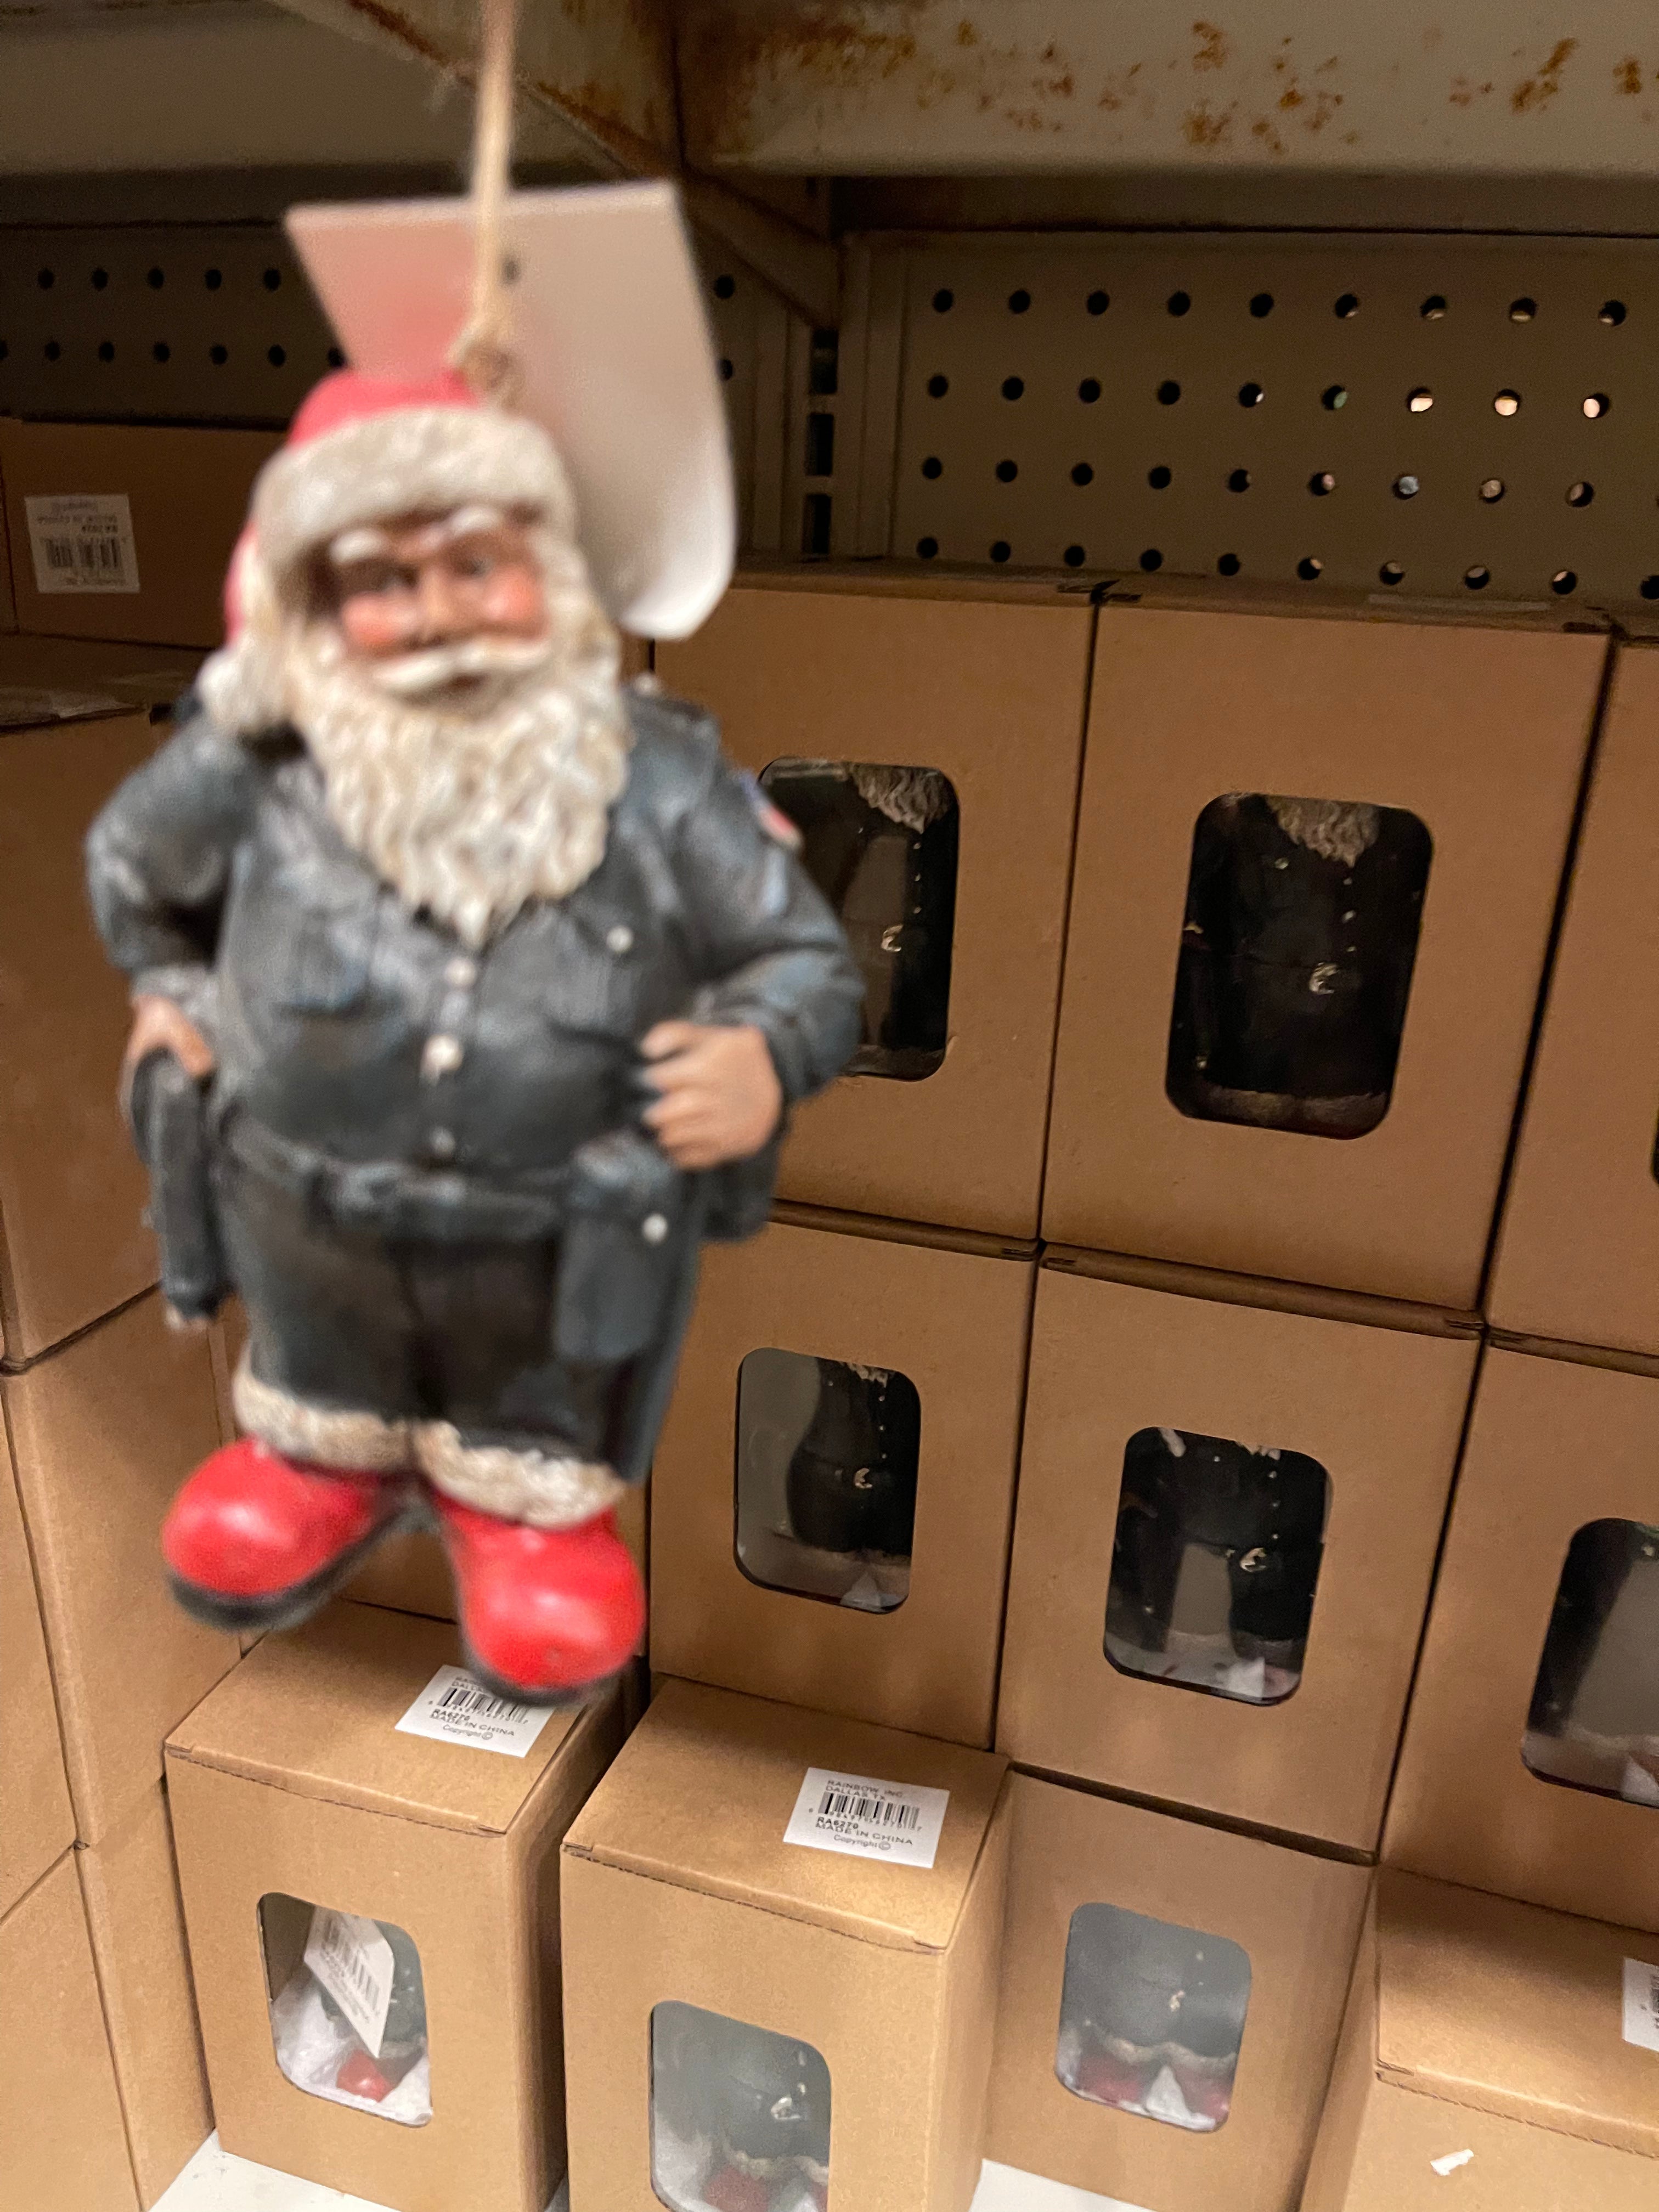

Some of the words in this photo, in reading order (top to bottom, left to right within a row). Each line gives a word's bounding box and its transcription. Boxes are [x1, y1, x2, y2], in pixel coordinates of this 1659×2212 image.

[479, 1724, 515, 1736] CHINA
[815, 1822, 852, 1835] MADE
[872, 1833, 913, 1845] CHINA
